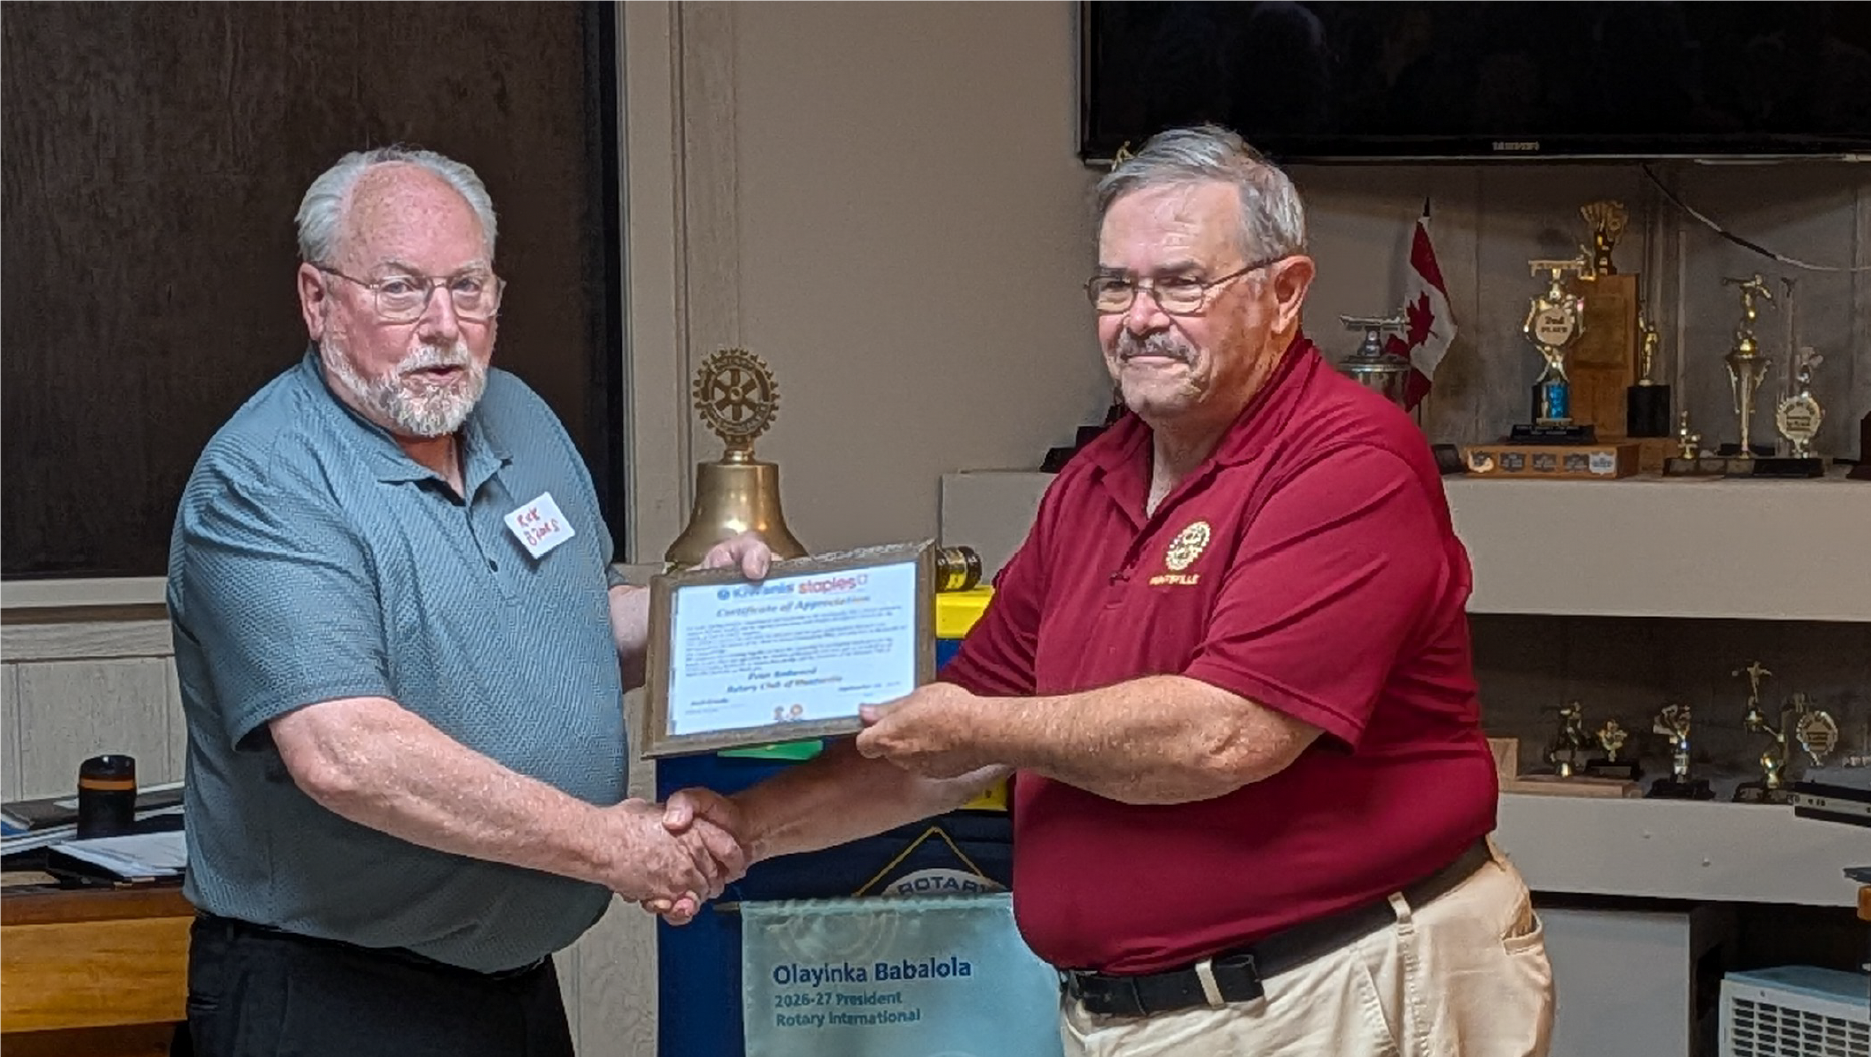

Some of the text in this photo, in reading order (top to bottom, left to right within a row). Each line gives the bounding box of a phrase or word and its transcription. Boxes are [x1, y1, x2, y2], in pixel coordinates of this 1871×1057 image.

[798, 577, 857, 594] staples
[716, 596, 871, 618] Certificate of Appreciation
[773, 956, 972, 988] Olayinka Babalola
[774, 990, 903, 1008] 2026-27 President
[776, 1008, 921, 1029] Rotary International
